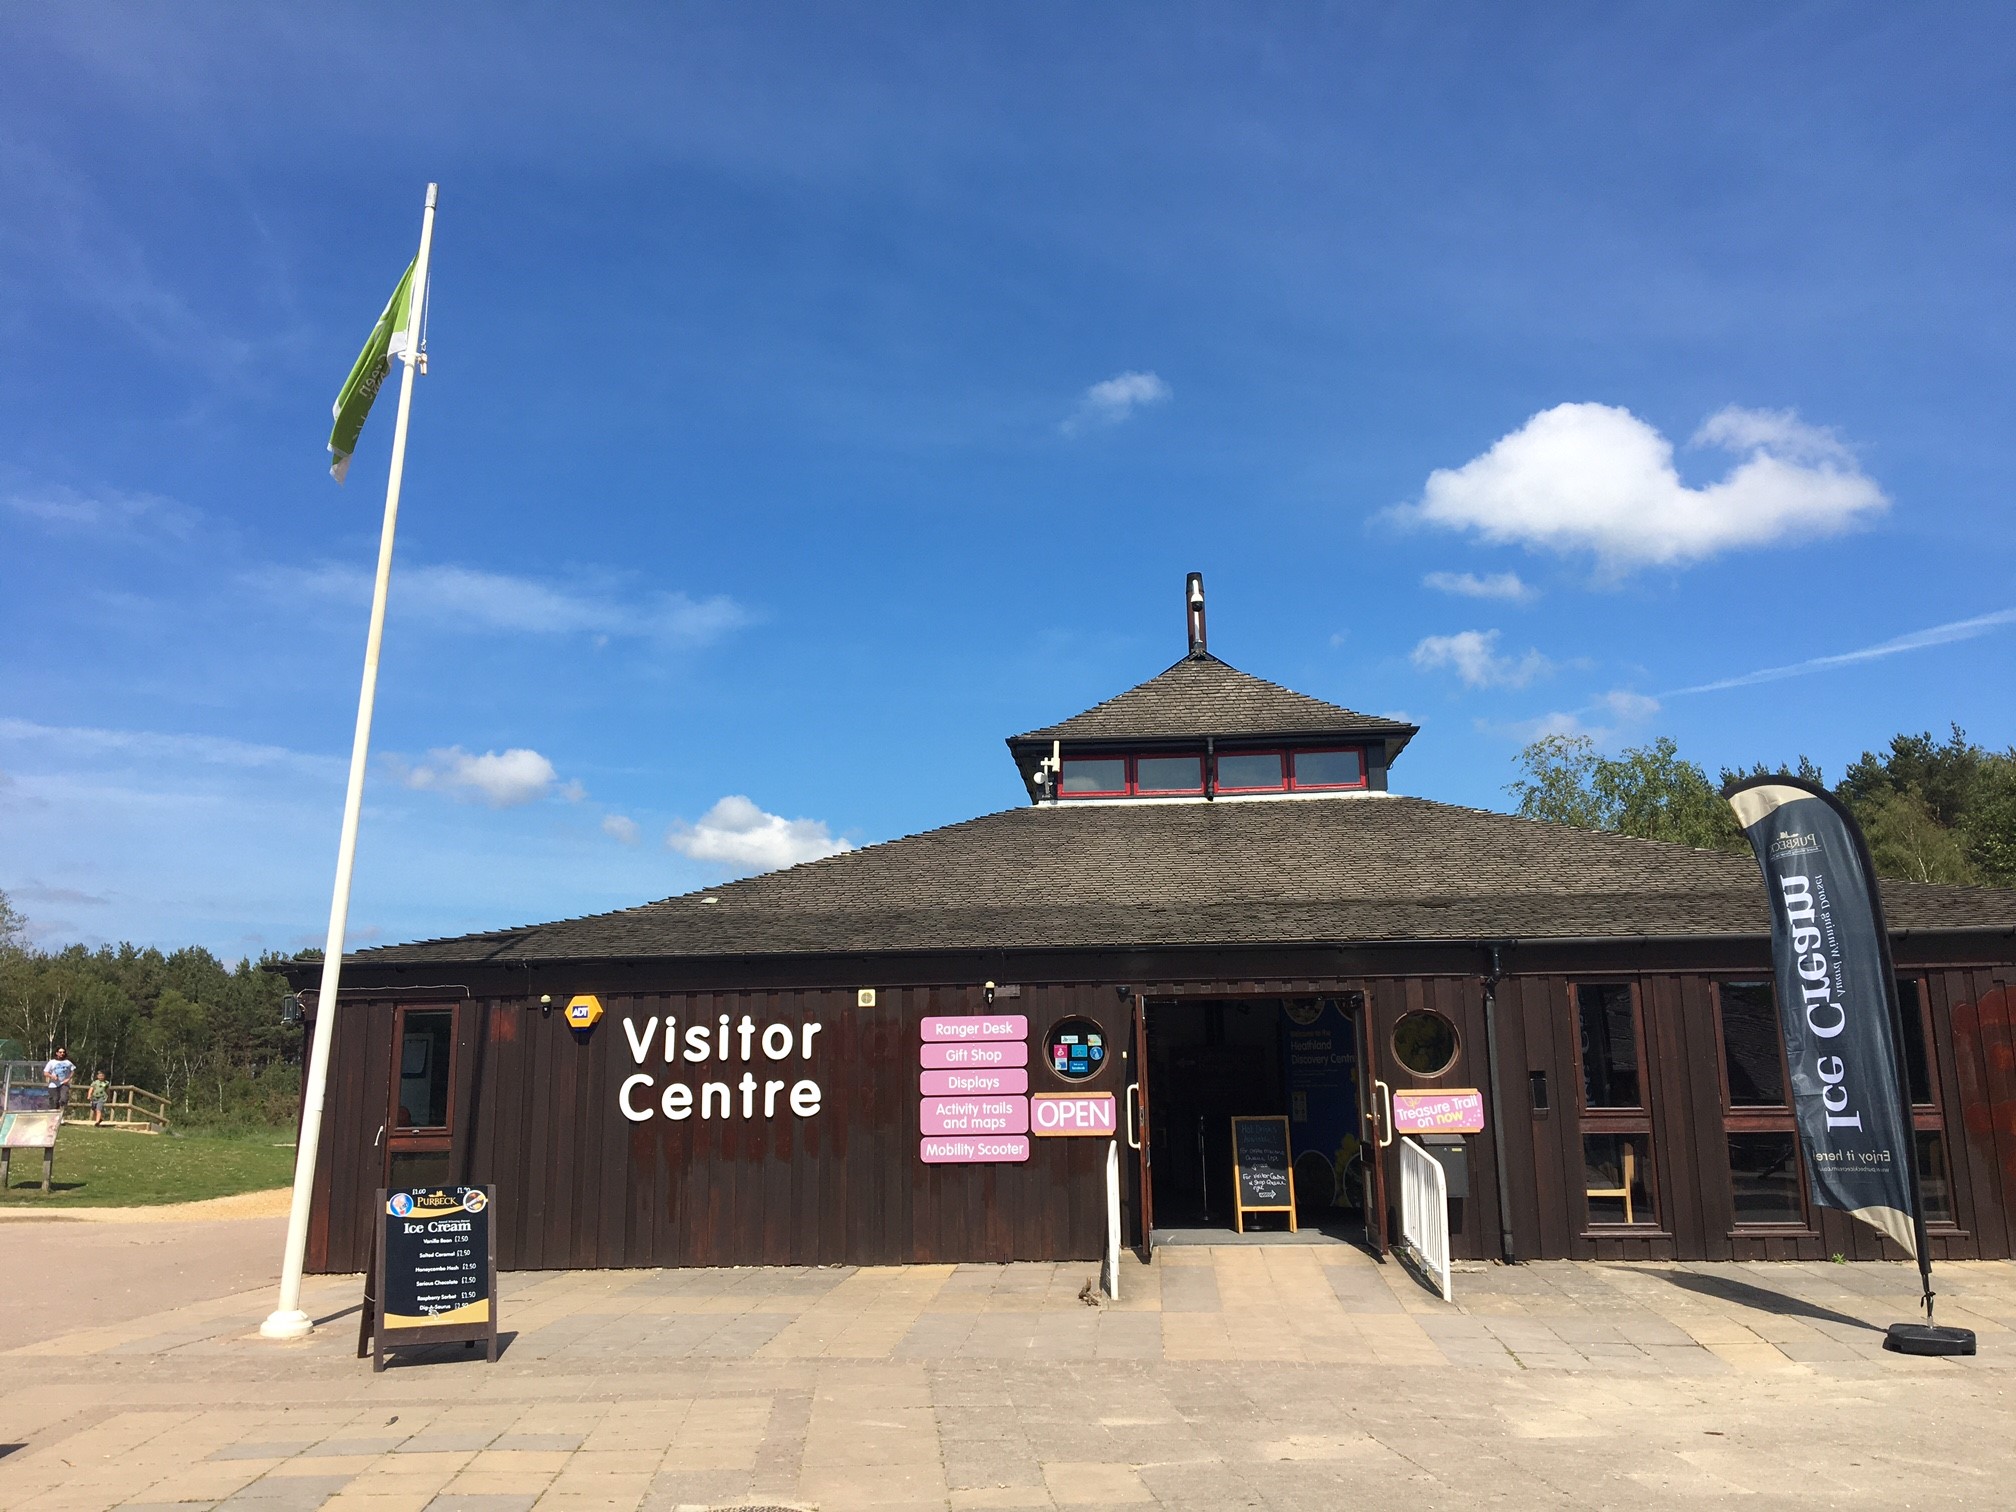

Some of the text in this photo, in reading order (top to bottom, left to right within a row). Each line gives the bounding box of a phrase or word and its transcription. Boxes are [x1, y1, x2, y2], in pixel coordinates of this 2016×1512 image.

[572, 1007, 589, 1017] ADT
[935, 1022, 1013, 1037] Ranger Desk
[622, 1014, 822, 1064] Visitor
[945, 1048, 1002, 1063] Gift Shop
[1291, 1054, 1329, 1066] Discovery
[948, 1076, 1000, 1091] Displays
[619, 1072, 822, 1122] Centre
[936, 1102, 1013, 1117] Activity trails
[1037, 1100, 1110, 1128] OPEN
[1397, 1094, 1478, 1121] Treasure Trail
[943, 1116, 1006, 1131] and maps
[1417, 1110, 1464, 1128] on now
[926, 1143, 1024, 1158] Mobility Scooter
[417, 1196, 459, 1208] PURBECK
[403, 1222, 424, 1234] Ice
[427, 1221, 472, 1233] Cream
